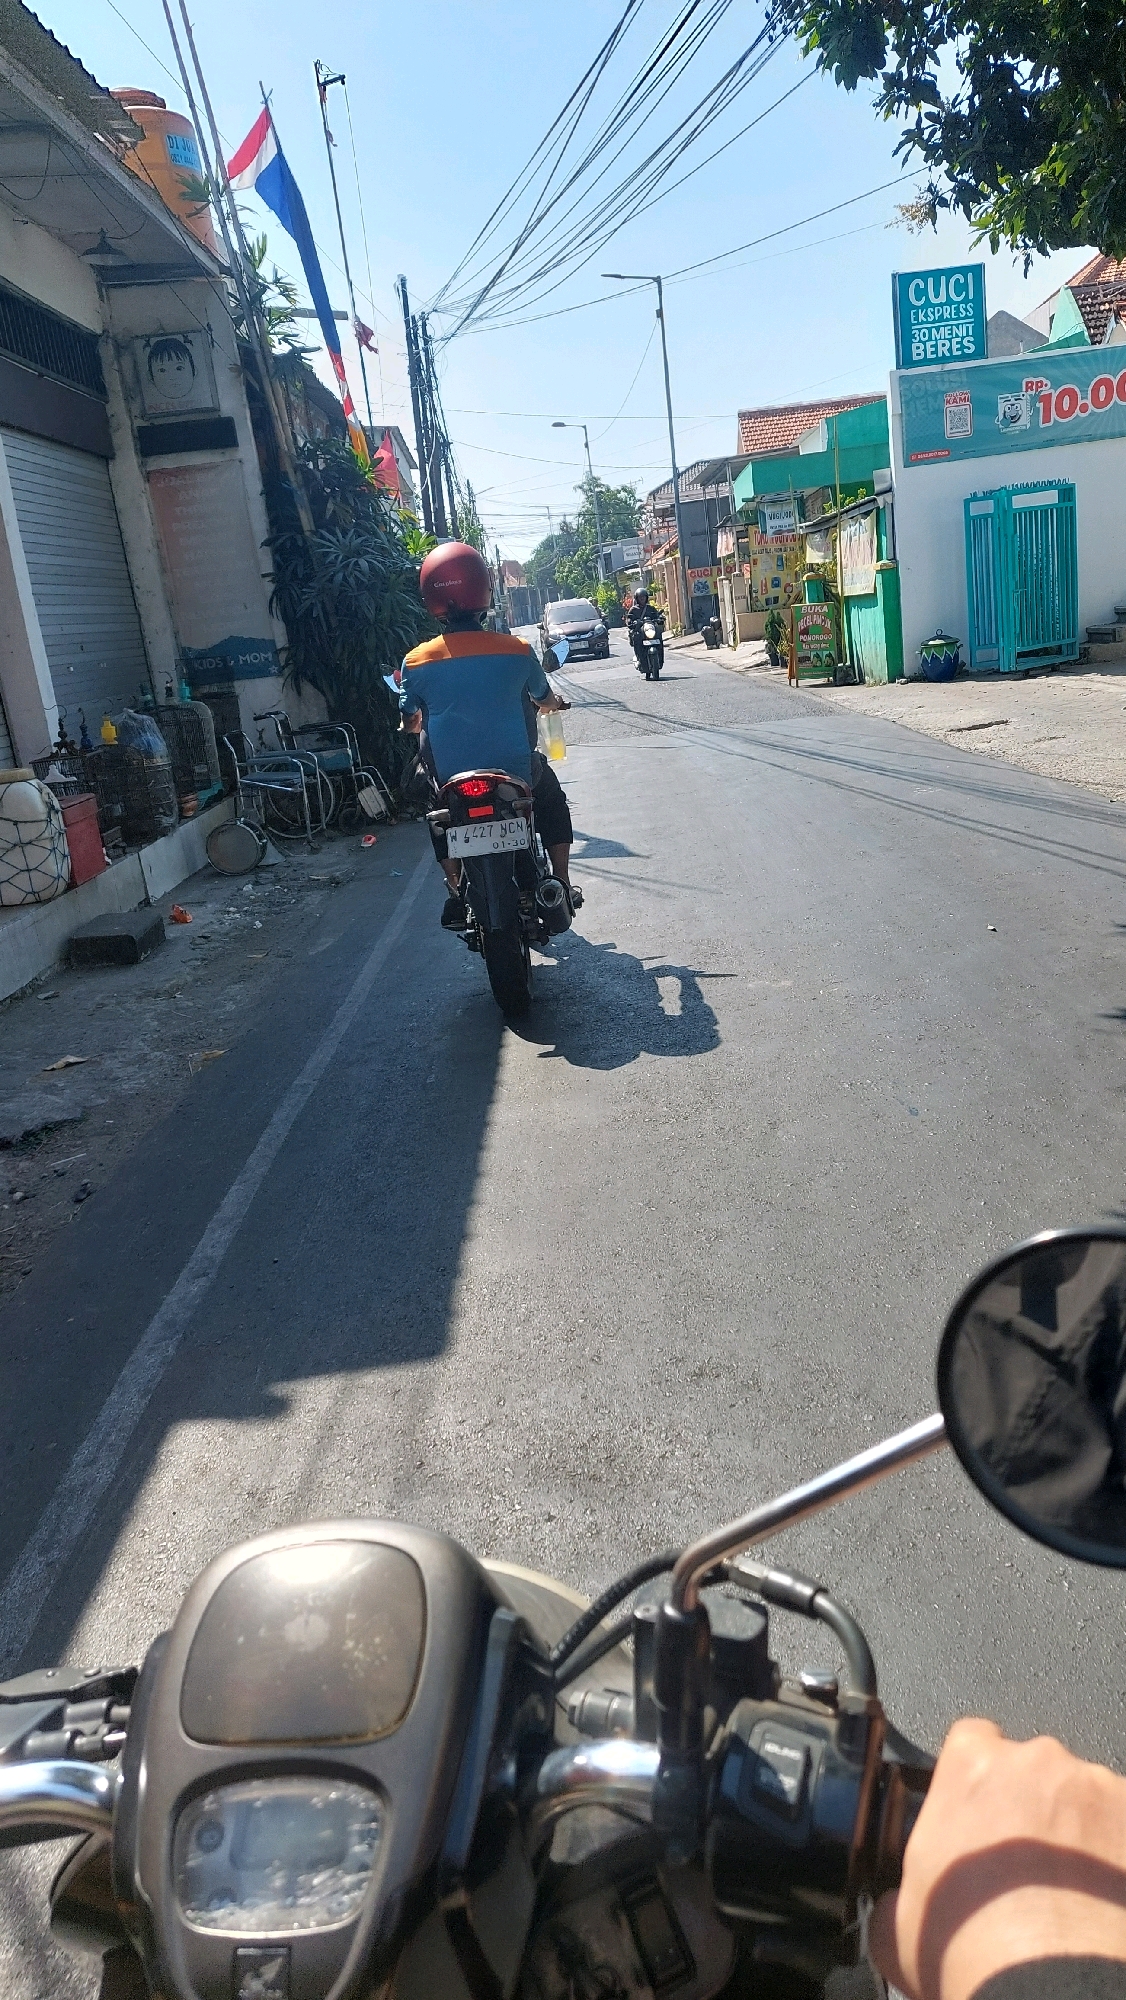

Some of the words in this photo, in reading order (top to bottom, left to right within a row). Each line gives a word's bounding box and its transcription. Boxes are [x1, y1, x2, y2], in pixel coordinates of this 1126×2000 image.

[908, 272, 974, 306] CUCI
[910, 303, 974, 323] EKSPRESS
[911, 328, 929, 342] 30
[931, 323, 975, 340] MENIT
[911, 336, 976, 360] BERES
[945, 395, 970, 405] KAMI
[689, 568, 713, 579] CUCI
[194, 656, 223, 670] KIDS
[238, 651, 273, 666] MOM
